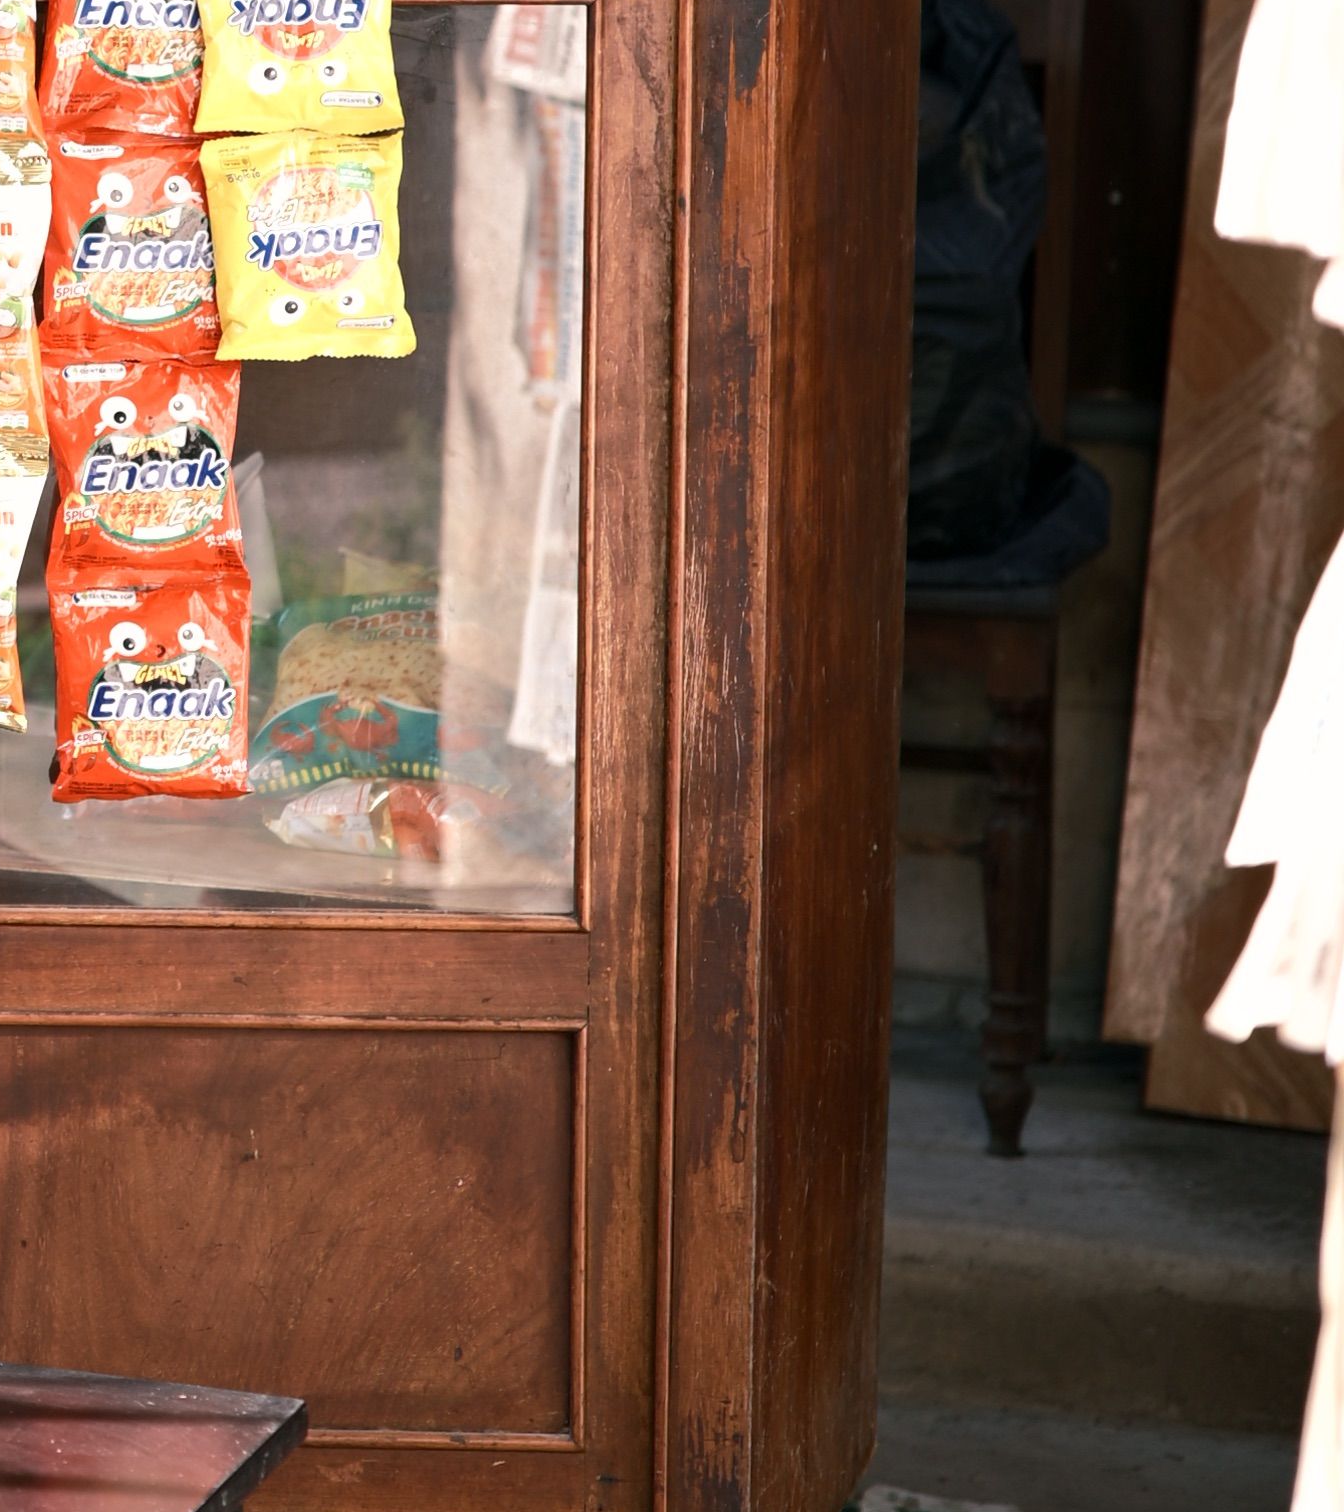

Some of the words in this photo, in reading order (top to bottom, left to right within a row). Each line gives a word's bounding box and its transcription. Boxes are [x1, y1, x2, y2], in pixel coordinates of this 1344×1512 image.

[247, 223, 381, 269] Enaak
[84, 451, 226, 492] Enaak
[65, 507, 98, 522] SPICY
[169, 498, 224, 526] Extra
[89, 681, 233, 718] Enaak
[175, 728, 230, 756] Extra
